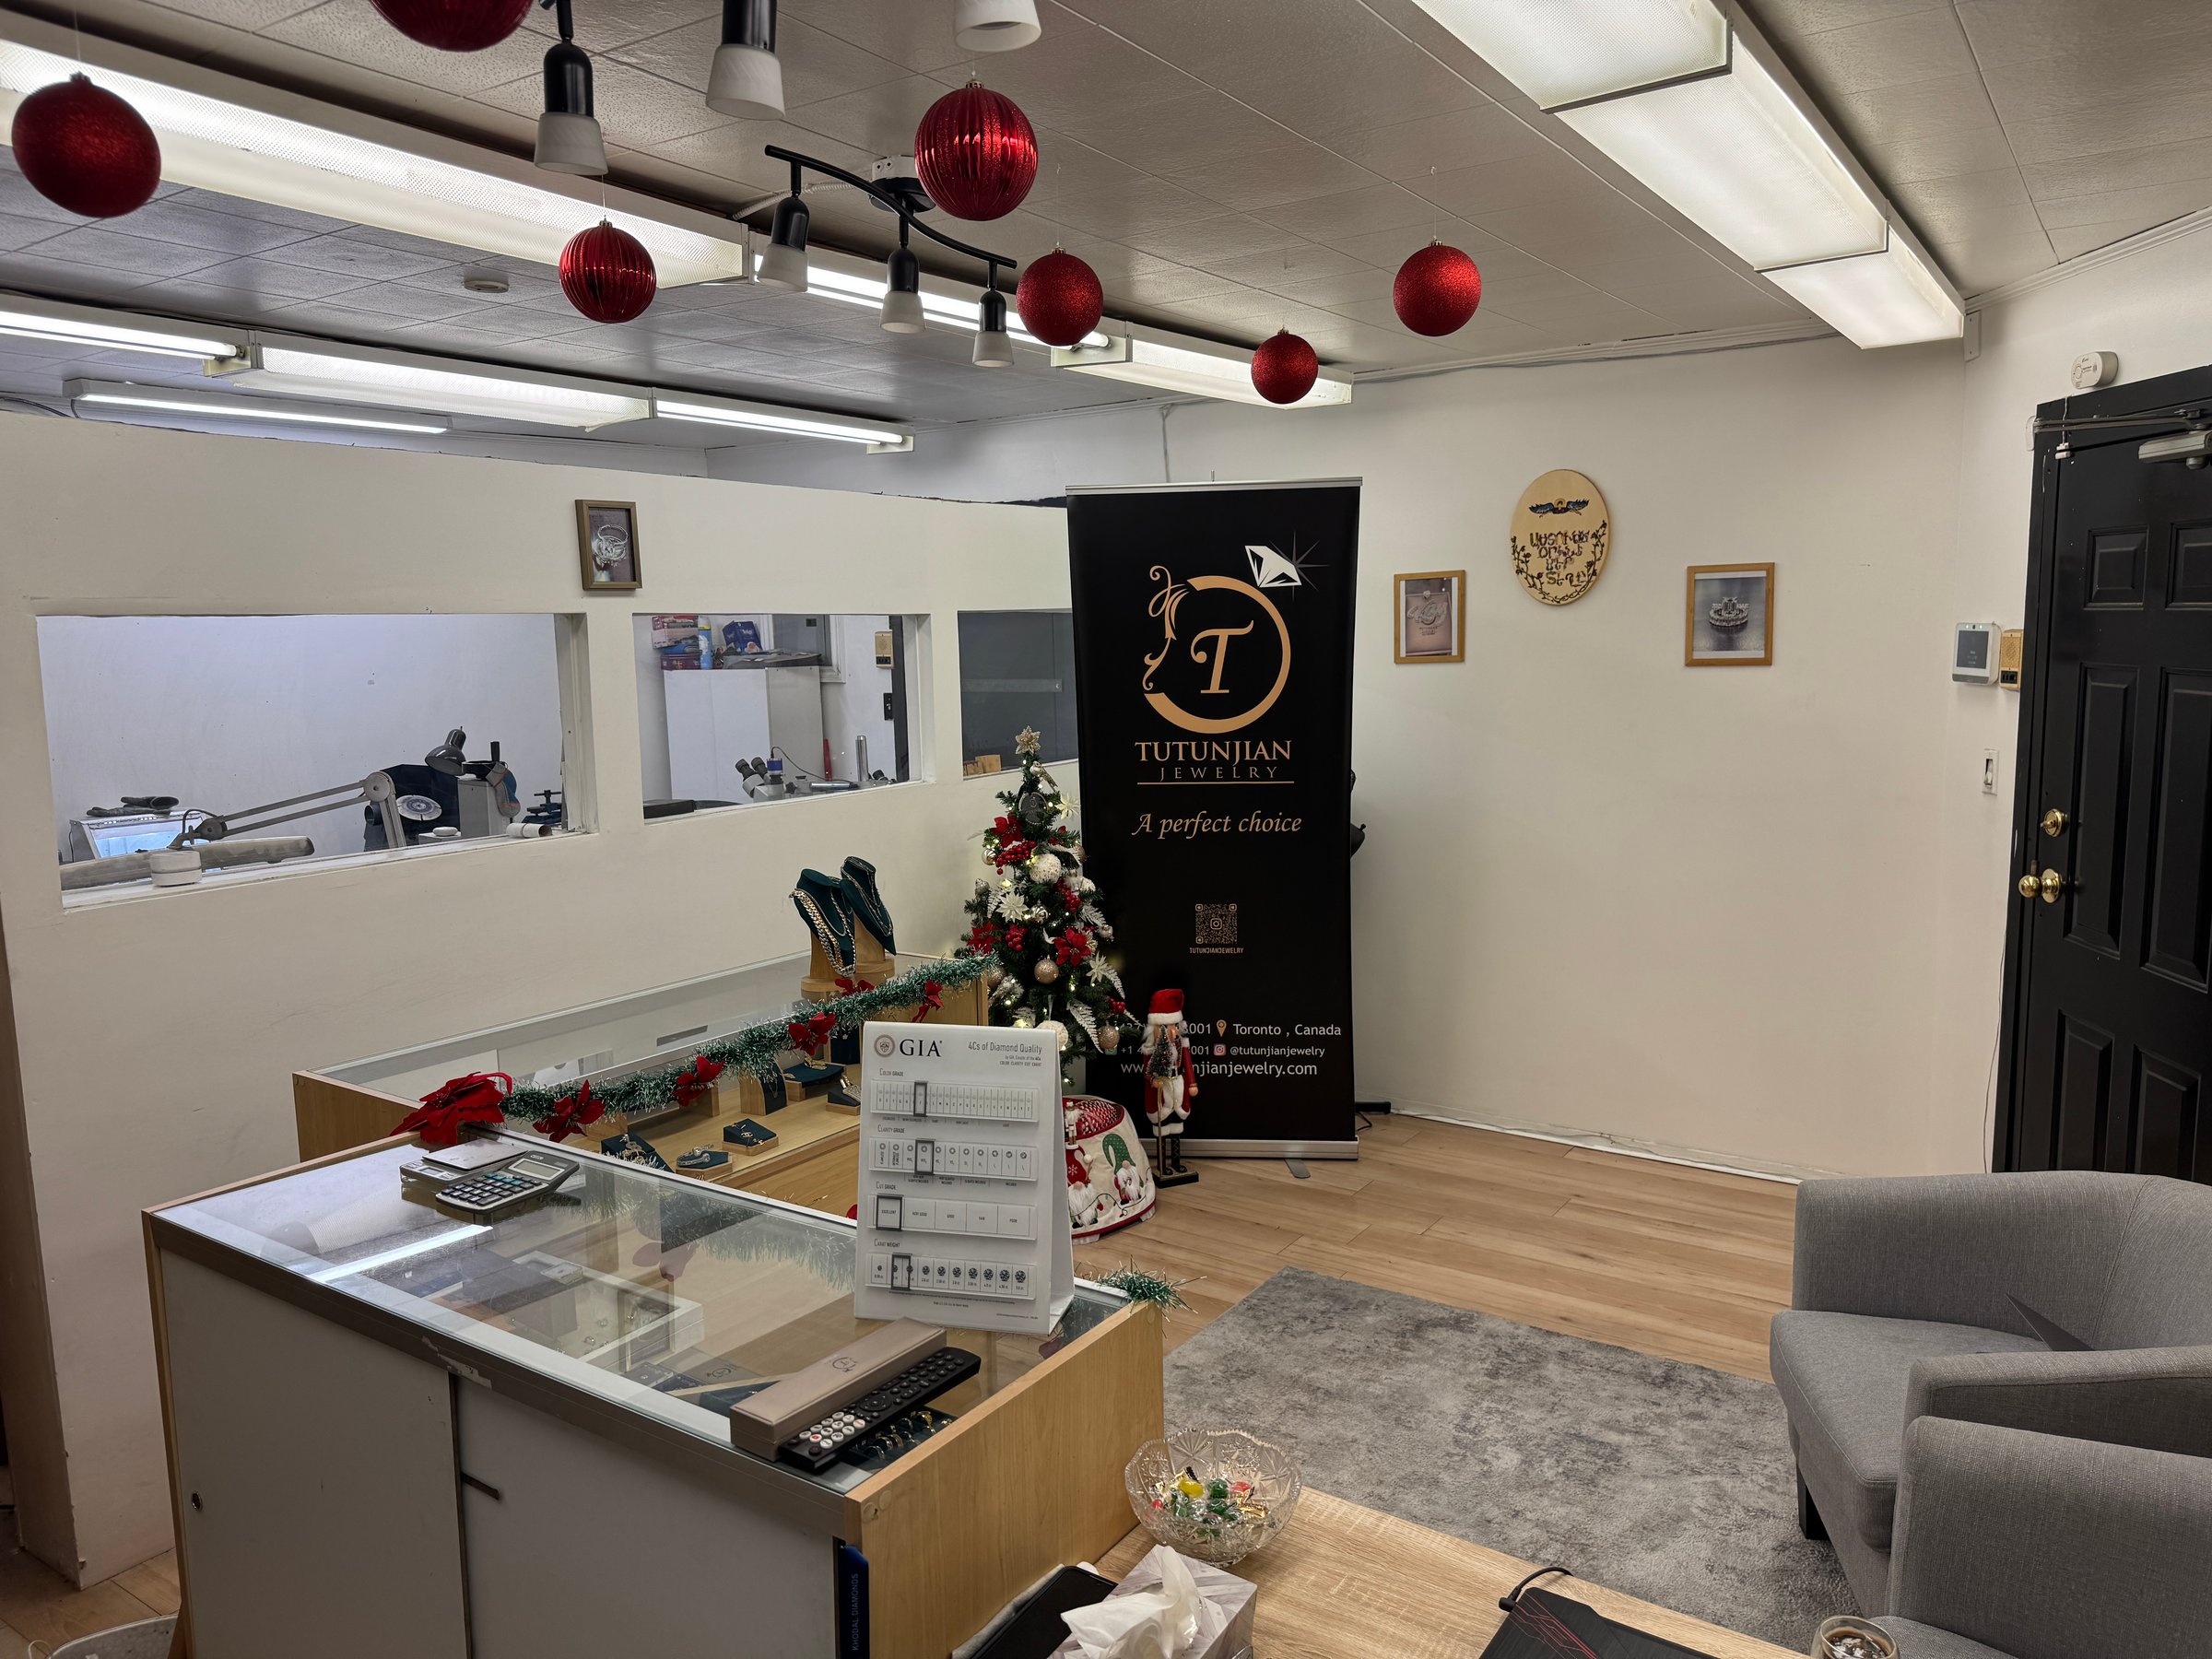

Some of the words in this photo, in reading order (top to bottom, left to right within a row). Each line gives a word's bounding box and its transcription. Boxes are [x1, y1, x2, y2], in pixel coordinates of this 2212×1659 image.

[1191, 620, 1253, 693] T
[1135, 740, 1292, 766] TUTUNJIAN
[1160, 767, 1277, 782] JEWELRY
[1132, 813, 1152, 836] A
[1158, 811, 1231, 840] perfect
[1238, 811, 1302, 832] choice
[1232, 1023, 1281, 1036] Toronto
[1294, 1023, 1342, 1036] Canada
[899, 1039, 941, 1057] GIA
[968, 1041, 981, 1051] 4Cs
[982, 1041, 989, 1051] of
[990, 1041, 1018, 1053] Diamond
[1019, 1043, 1042, 1055] Quality
[1189, 1045, 1209, 1055] 001
[1230, 1046, 1325, 1058] @tutunjianjewelry
[1121, 1061, 1318, 1077] wwnjianjewelry.com
[851, 1573, 859, 1616] DIAMONDS
[851, 1617, 859, 1651] KHODAL
